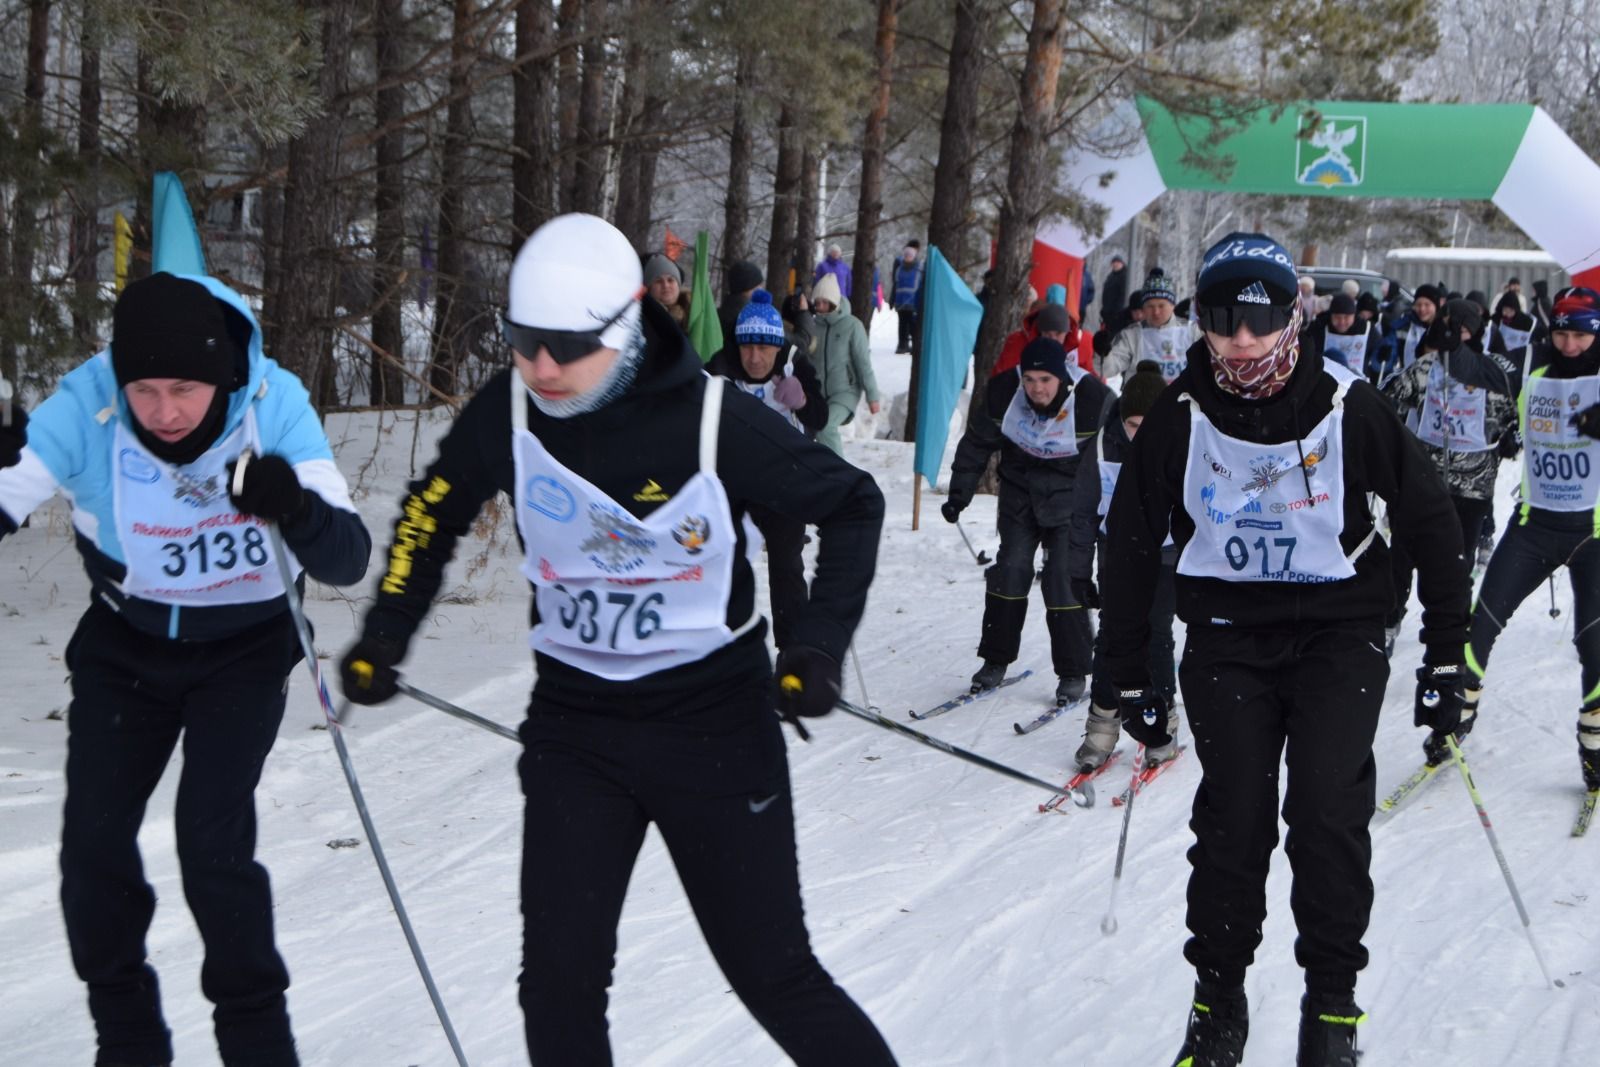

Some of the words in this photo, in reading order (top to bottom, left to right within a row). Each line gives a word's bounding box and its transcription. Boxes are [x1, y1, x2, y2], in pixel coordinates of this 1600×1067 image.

[1237, 293, 1271, 305] adidas
[1532, 449, 1591, 481] 3600
[161, 526, 268, 577] 3138
[1225, 535, 1297, 574] 017
